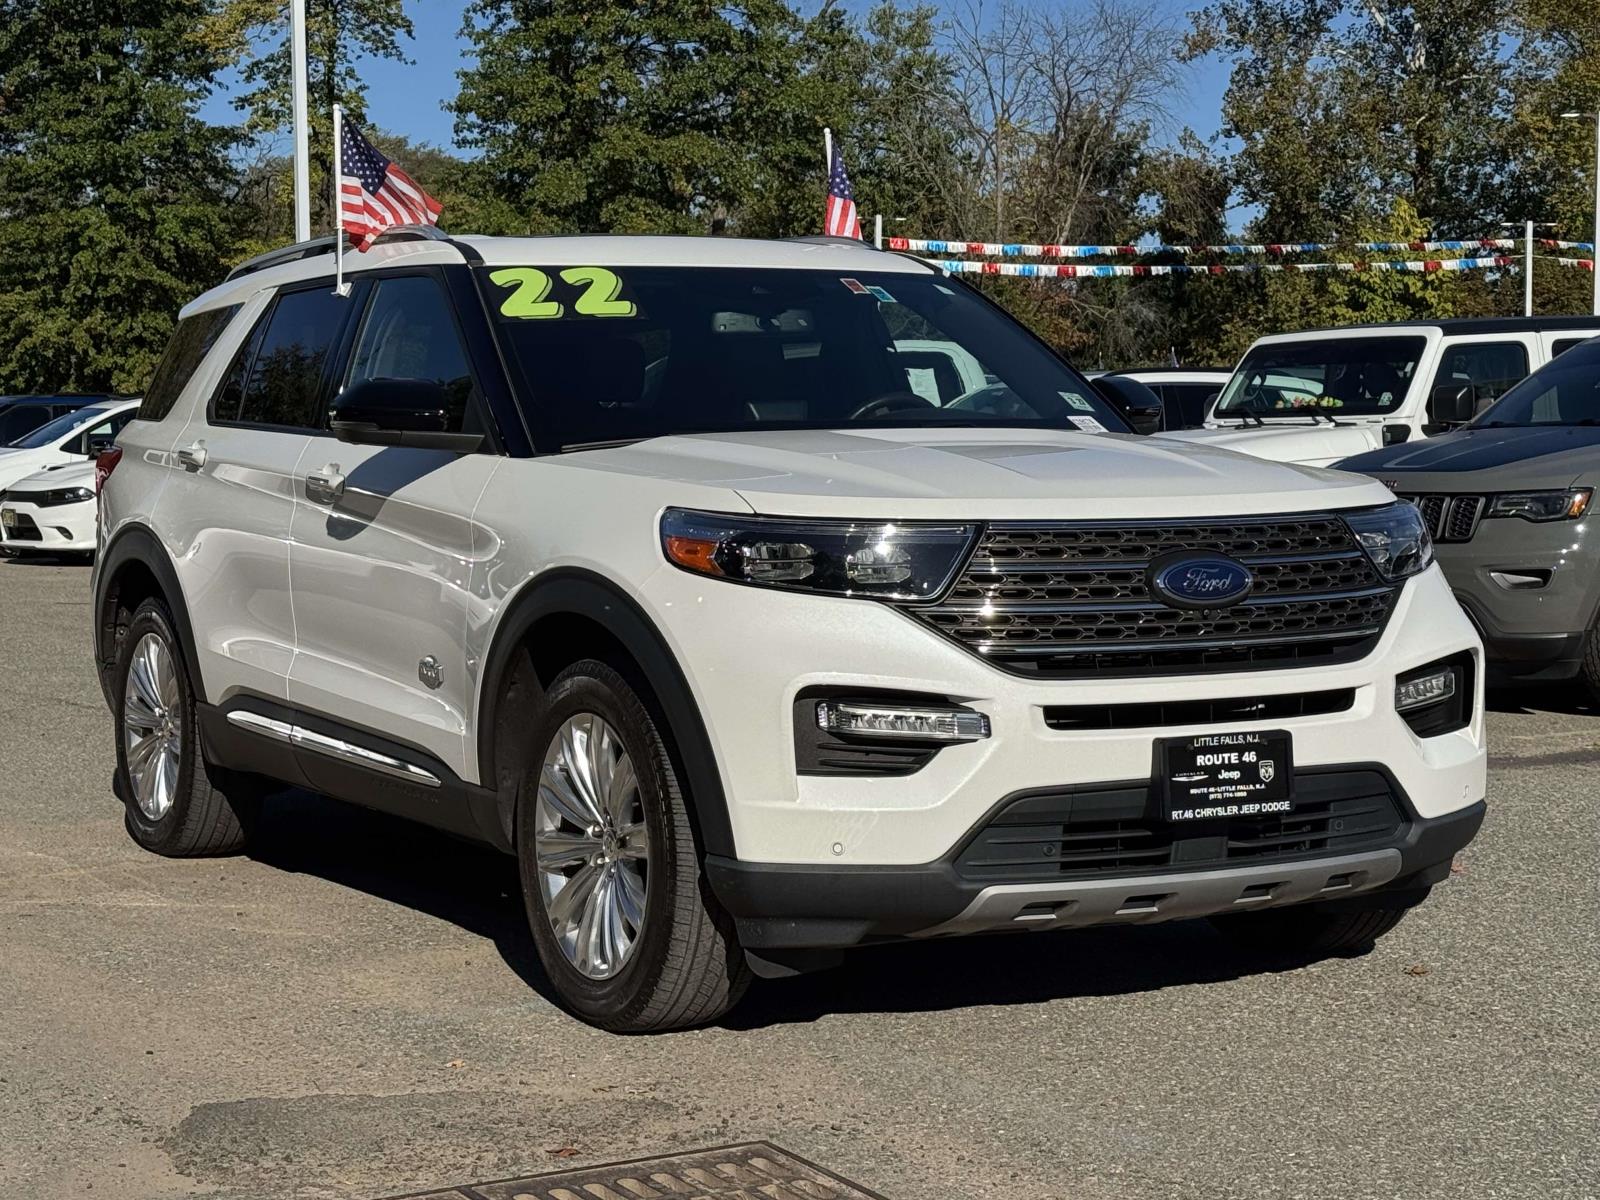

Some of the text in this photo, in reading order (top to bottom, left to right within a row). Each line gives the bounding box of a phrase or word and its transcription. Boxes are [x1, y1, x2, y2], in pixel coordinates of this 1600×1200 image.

[489, 267, 637, 319] 22
[1175, 562, 1215, 582] Ford
[1194, 734, 1260, 747] LITTLE FALLS, N.J.
[1196, 751, 1257, 766] ROUTE 46
[1218, 770, 1241, 780] Jeep
[1194, 805, 1239, 818] CHRYSLER
[1239, 803, 1260, 814] JEEP
[1261, 801, 1290, 812] DODGE
